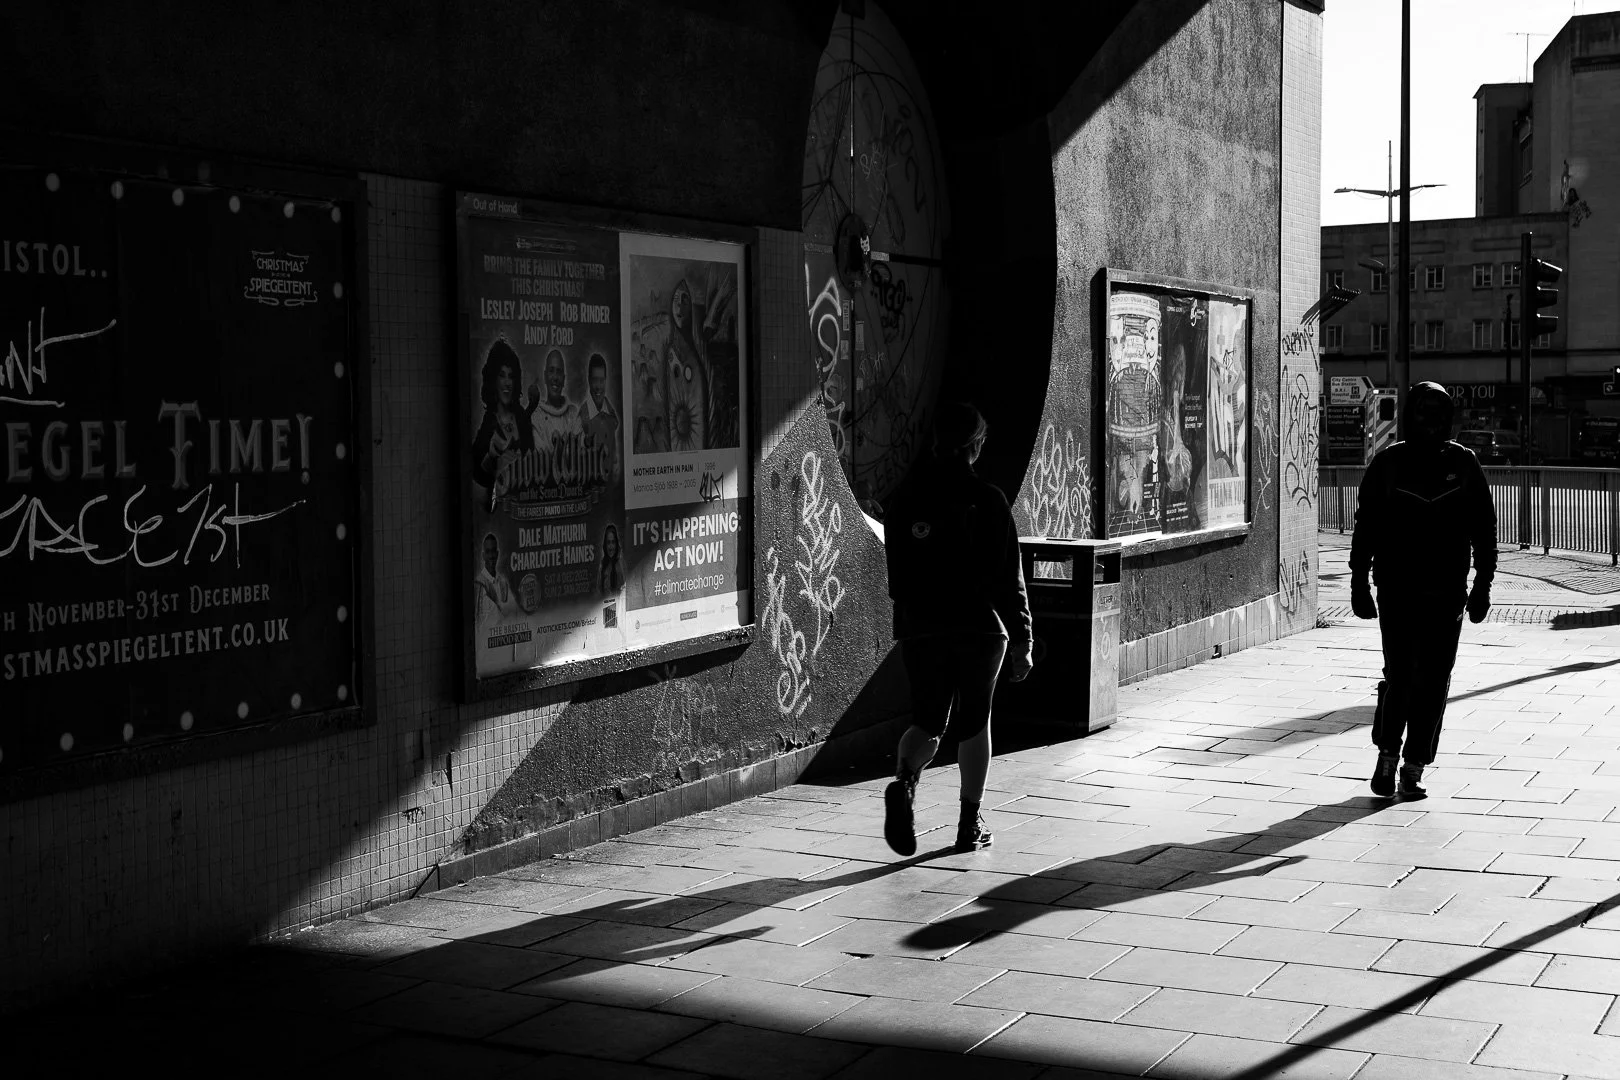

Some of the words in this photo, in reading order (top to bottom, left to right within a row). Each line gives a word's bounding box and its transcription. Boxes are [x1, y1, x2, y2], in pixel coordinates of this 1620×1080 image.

[0, 239, 108, 279] ISTOL..
[256, 257, 304, 273] CHRISTMAS
[483, 253, 513, 274] BRING
[514, 257, 532, 276] THE
[533, 258, 563, 278] FAMILY
[564, 261, 605, 281] TOGETHER
[249, 277, 312, 296] SPIEGELTENT
[511, 277, 532, 295] THIS
[480, 297, 516, 321] LESLEY
[518, 299, 554, 322] JOSEPH
[560, 301, 579, 323] ROB
[580, 303, 611, 325] RINDER
[523, 324, 549, 346] ANDY
[550, 325, 574, 347] FORD
[1470, 385, 1495, 399] YOU
[4, 420, 137, 483] EGEL
[157, 398, 314, 492] TIME!
[633, 466, 656, 477] MOTHER
[656, 465, 674, 475] EARTH
[675, 464, 681, 474] IN
[681, 463, 694, 473] PAIN
[544, 504, 561, 516] PANTO
[518, 527, 542, 549] DALE
[543, 522, 587, 545] MATHURIN
[633, 520, 660, 546] IT'S
[510, 548, 561, 572] CHARLOTTE
[563, 544, 595, 565] HAINES
[653, 547, 683, 572] ACT
[685, 539, 724, 567] NOW!
[654, 573, 725, 597] #climatechange
[504, 622, 530, 634] BRISTOL
[3, 617, 289, 681] STMASSPIEGELTENT.CO.UK
